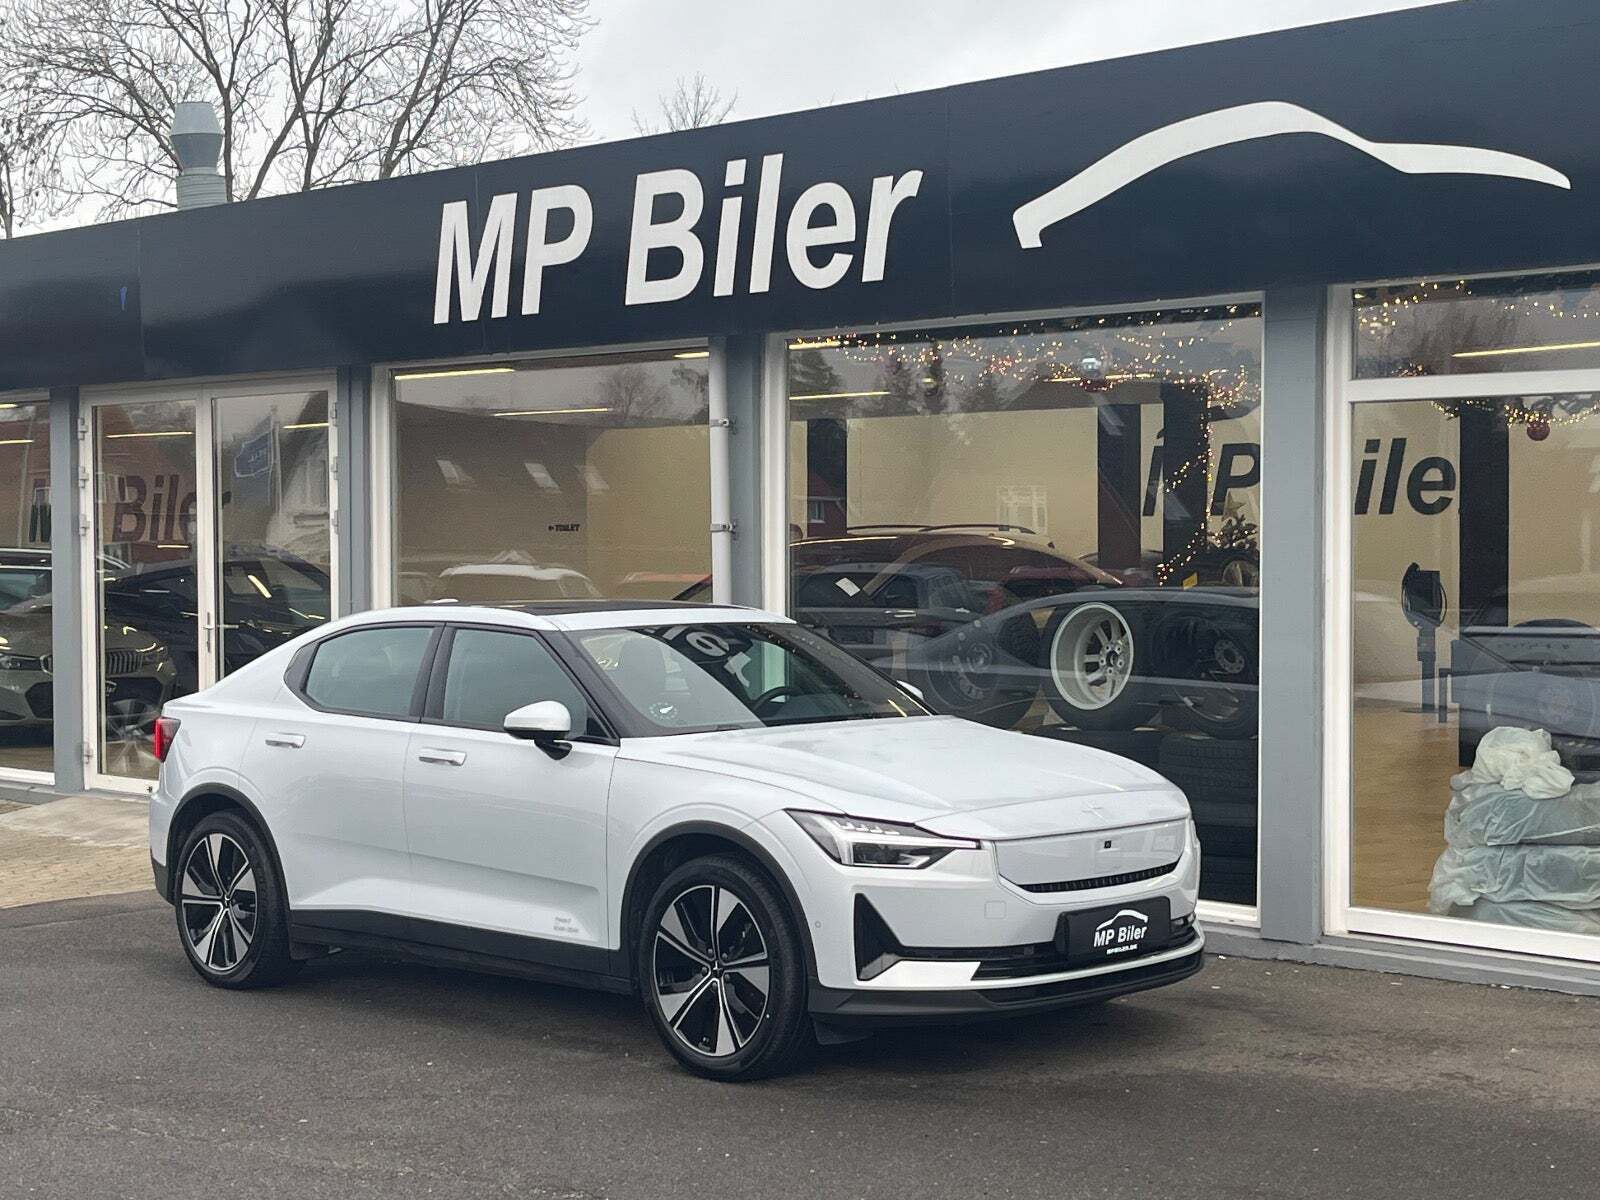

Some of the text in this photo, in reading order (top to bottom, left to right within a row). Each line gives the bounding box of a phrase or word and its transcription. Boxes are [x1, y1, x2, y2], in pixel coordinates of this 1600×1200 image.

[433, 153, 924, 325] MP Biler
[1354, 437, 1459, 516] ile
[1093, 924, 1148, 948] MP Biler
